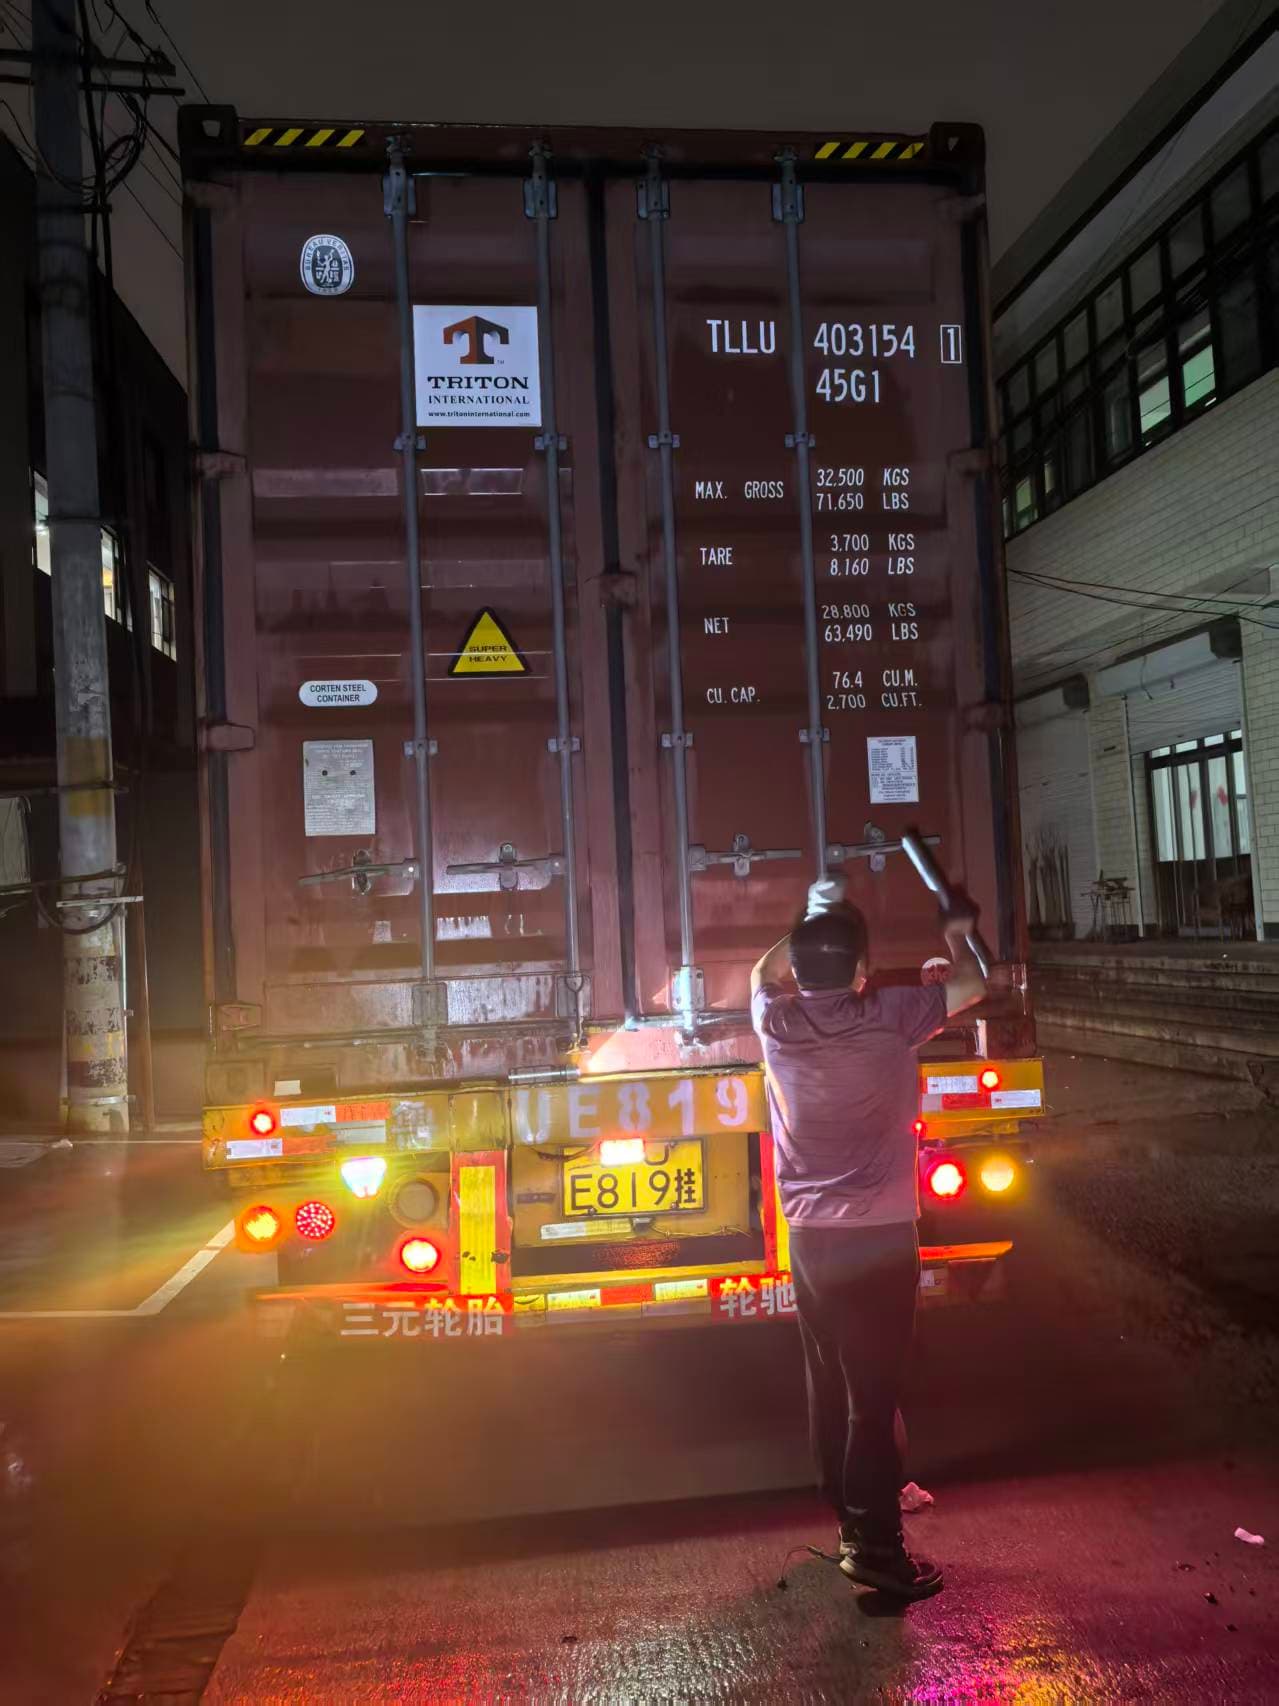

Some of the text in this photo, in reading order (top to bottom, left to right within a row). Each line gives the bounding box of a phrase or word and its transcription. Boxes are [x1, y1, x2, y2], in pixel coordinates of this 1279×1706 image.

[706, 319, 959, 362] TLLU 403154 1
[427, 376, 529, 390] TRITON
[816, 369, 880, 403] 45G1
[428, 395, 530, 405] INTERNATIONAL
[428, 410, 531, 418] www.tritoninternational.com
[816, 468, 910, 487] 32,500 KGS
[695, 481, 784, 499] MAX. GROSS
[882, 492, 909, 510] LBS
[887, 533, 915, 551] KGS
[700, 547, 733, 565] TARE
[887, 557, 914, 575] LBS
[888, 603, 916, 617] KGS
[704, 617, 729, 634] NET
[891, 622, 919, 640] LBS
[310, 683, 367, 692] CORTEN STEEL
[832, 671, 863, 689] 76.4
[317, 694, 360, 703] CONTAINER
[513, 1077, 750, 1145] UE819
[569, 1167, 697, 1211] E819挂
[340, 1297, 504, 1337] 三元轮胎
